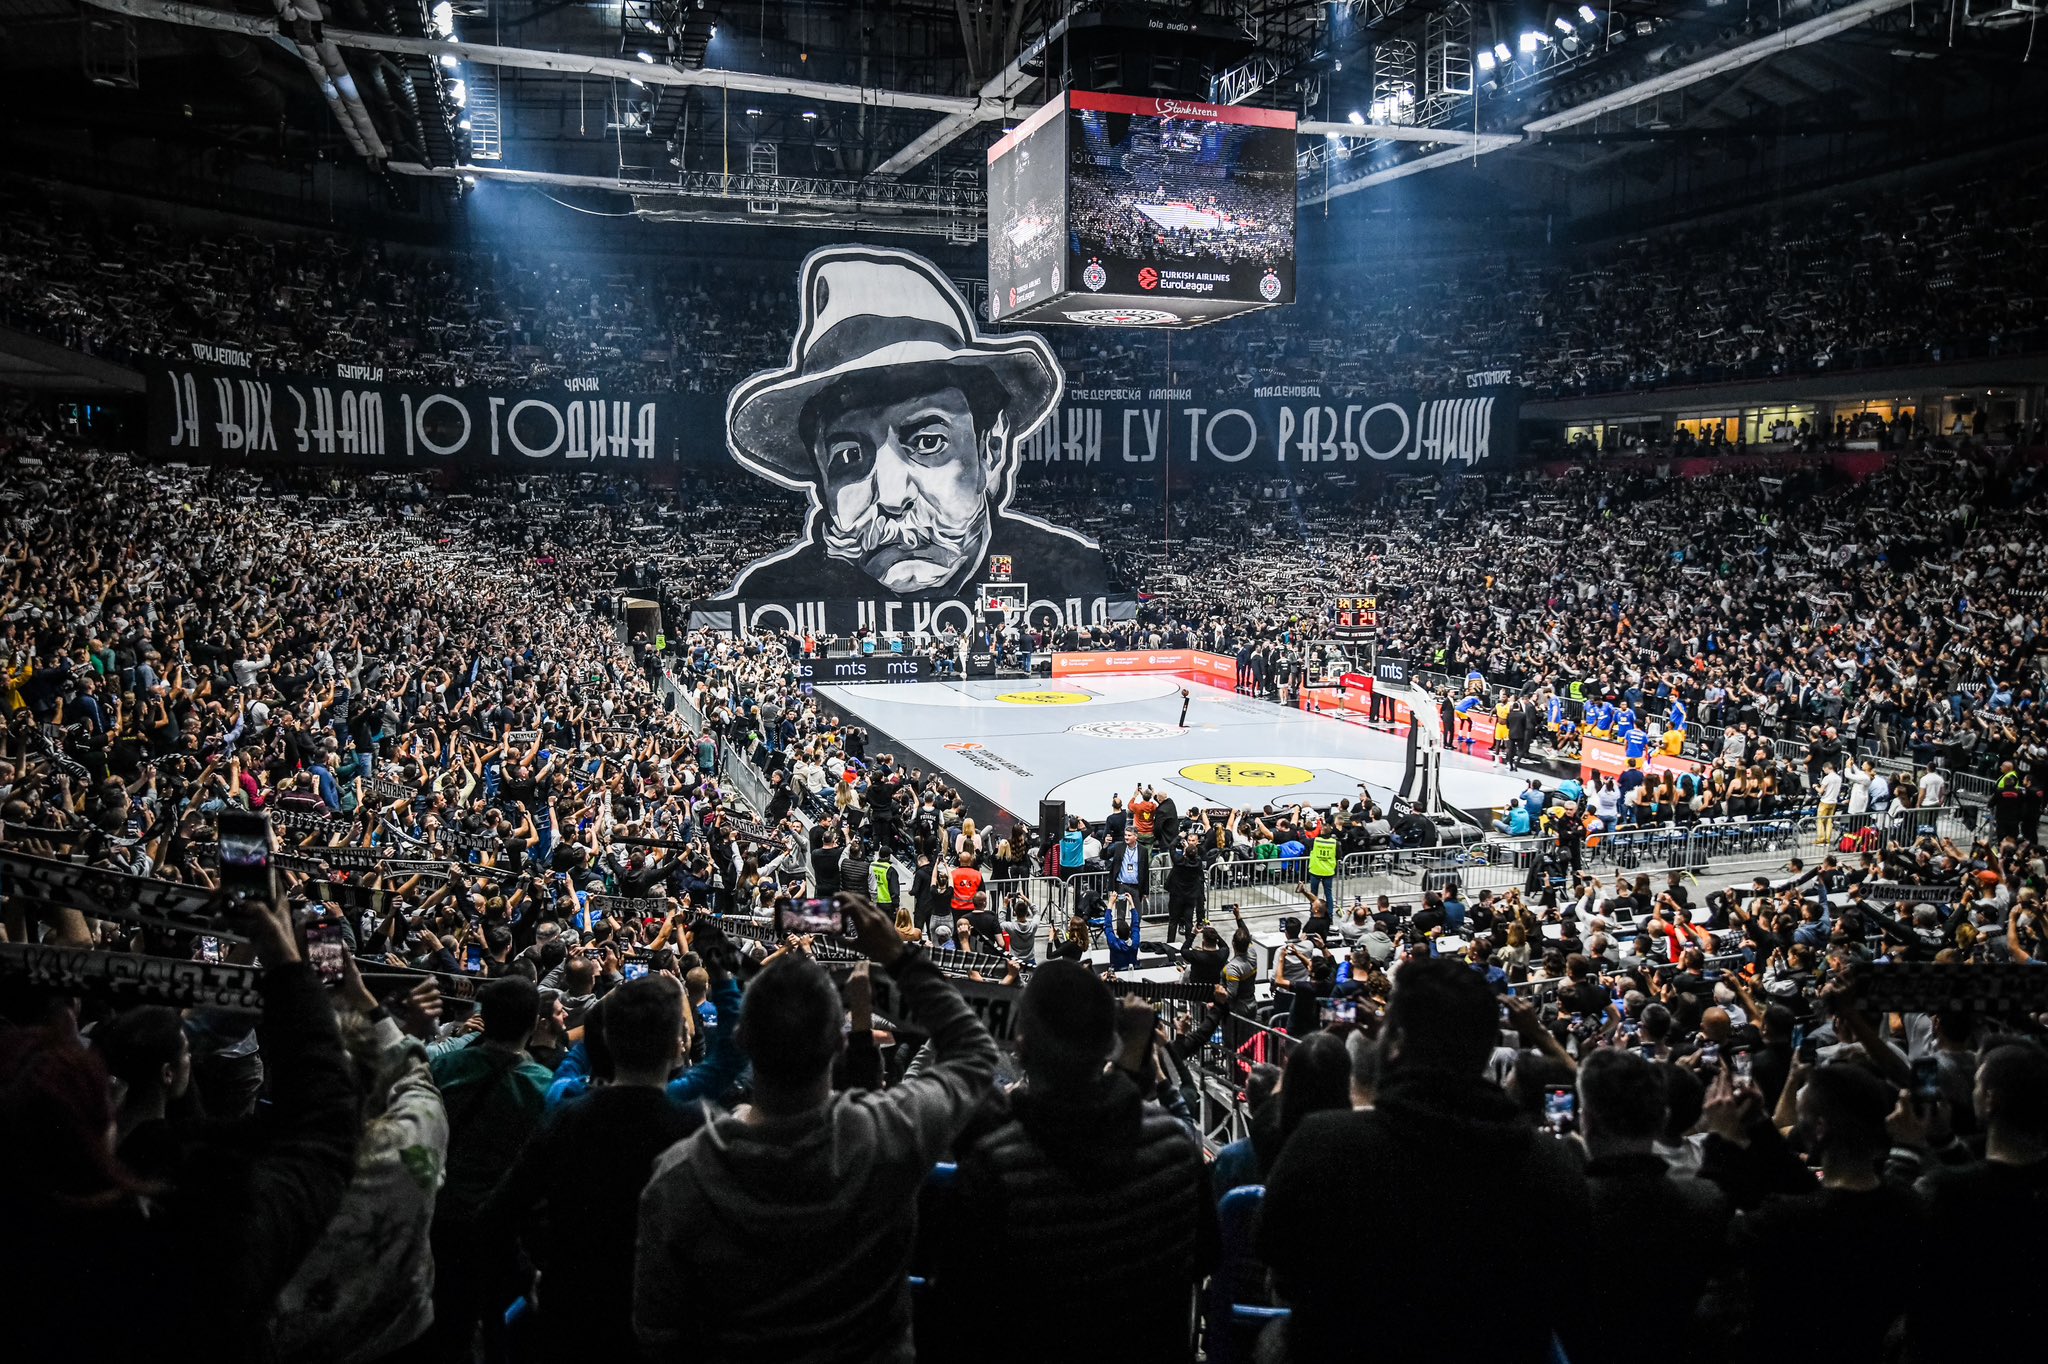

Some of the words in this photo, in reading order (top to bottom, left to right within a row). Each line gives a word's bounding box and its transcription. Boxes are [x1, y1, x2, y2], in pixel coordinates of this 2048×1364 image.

[1167, 23, 1189, 32] audio
[1160, 270, 1195, 280] TURKISH
[1196, 272, 1230, 283] AIRLINES
[1160, 280, 1214, 292] EuroLeague
[192, 343, 252, 368] ПРИЈЕПОЉЕ
[564, 377, 600, 392] ЧАЧАК
[1466, 370, 1511, 388] СУТОМОРЕ
[1071, 389, 1141, 400] СМЕДЕРЕВСКА
[1149, 389, 1192, 400] ПАЛАНКА
[1254, 386, 1321, 398] МЛАДЕНОВАЦ
[168, 370, 200, 447] ЈА
[213, 377, 278, 457] ЊИХ
[287, 385, 386, 455] ЗНАМ
[488, 396, 656, 462] ГОДИНА
[1122, 408, 1161, 463] СУ
[1183, 408, 1257, 463] ТО
[1277, 396, 1495, 467] РАЗБОЈНИЦИ
[1356, 598, 1376, 609] 3:24
[1360, 612, 1376, 626] 24
[800, 664, 813, 677] ts
[836, 662, 866, 676] mts
[888, 661, 918, 674] mts
[1381, 662, 1403, 680] mts
